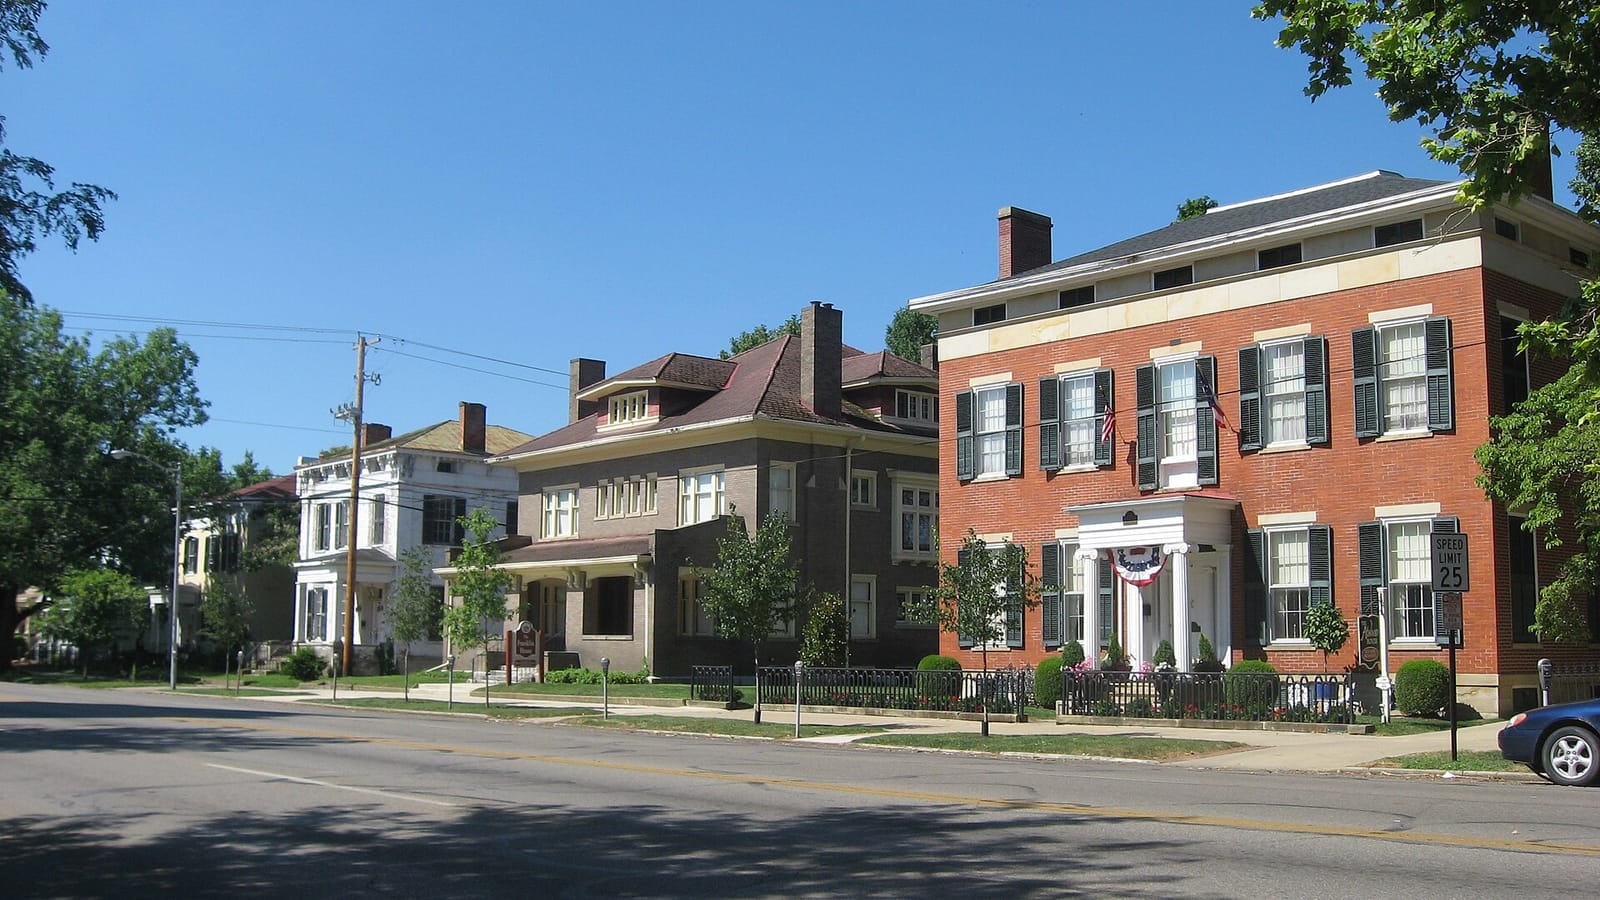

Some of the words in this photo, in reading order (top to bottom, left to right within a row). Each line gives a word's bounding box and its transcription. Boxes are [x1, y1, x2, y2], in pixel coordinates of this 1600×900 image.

[1436, 538, 1463, 550] SPEED
[1439, 552, 1462, 564] LIMIT
[1440, 567, 1462, 587] 25
